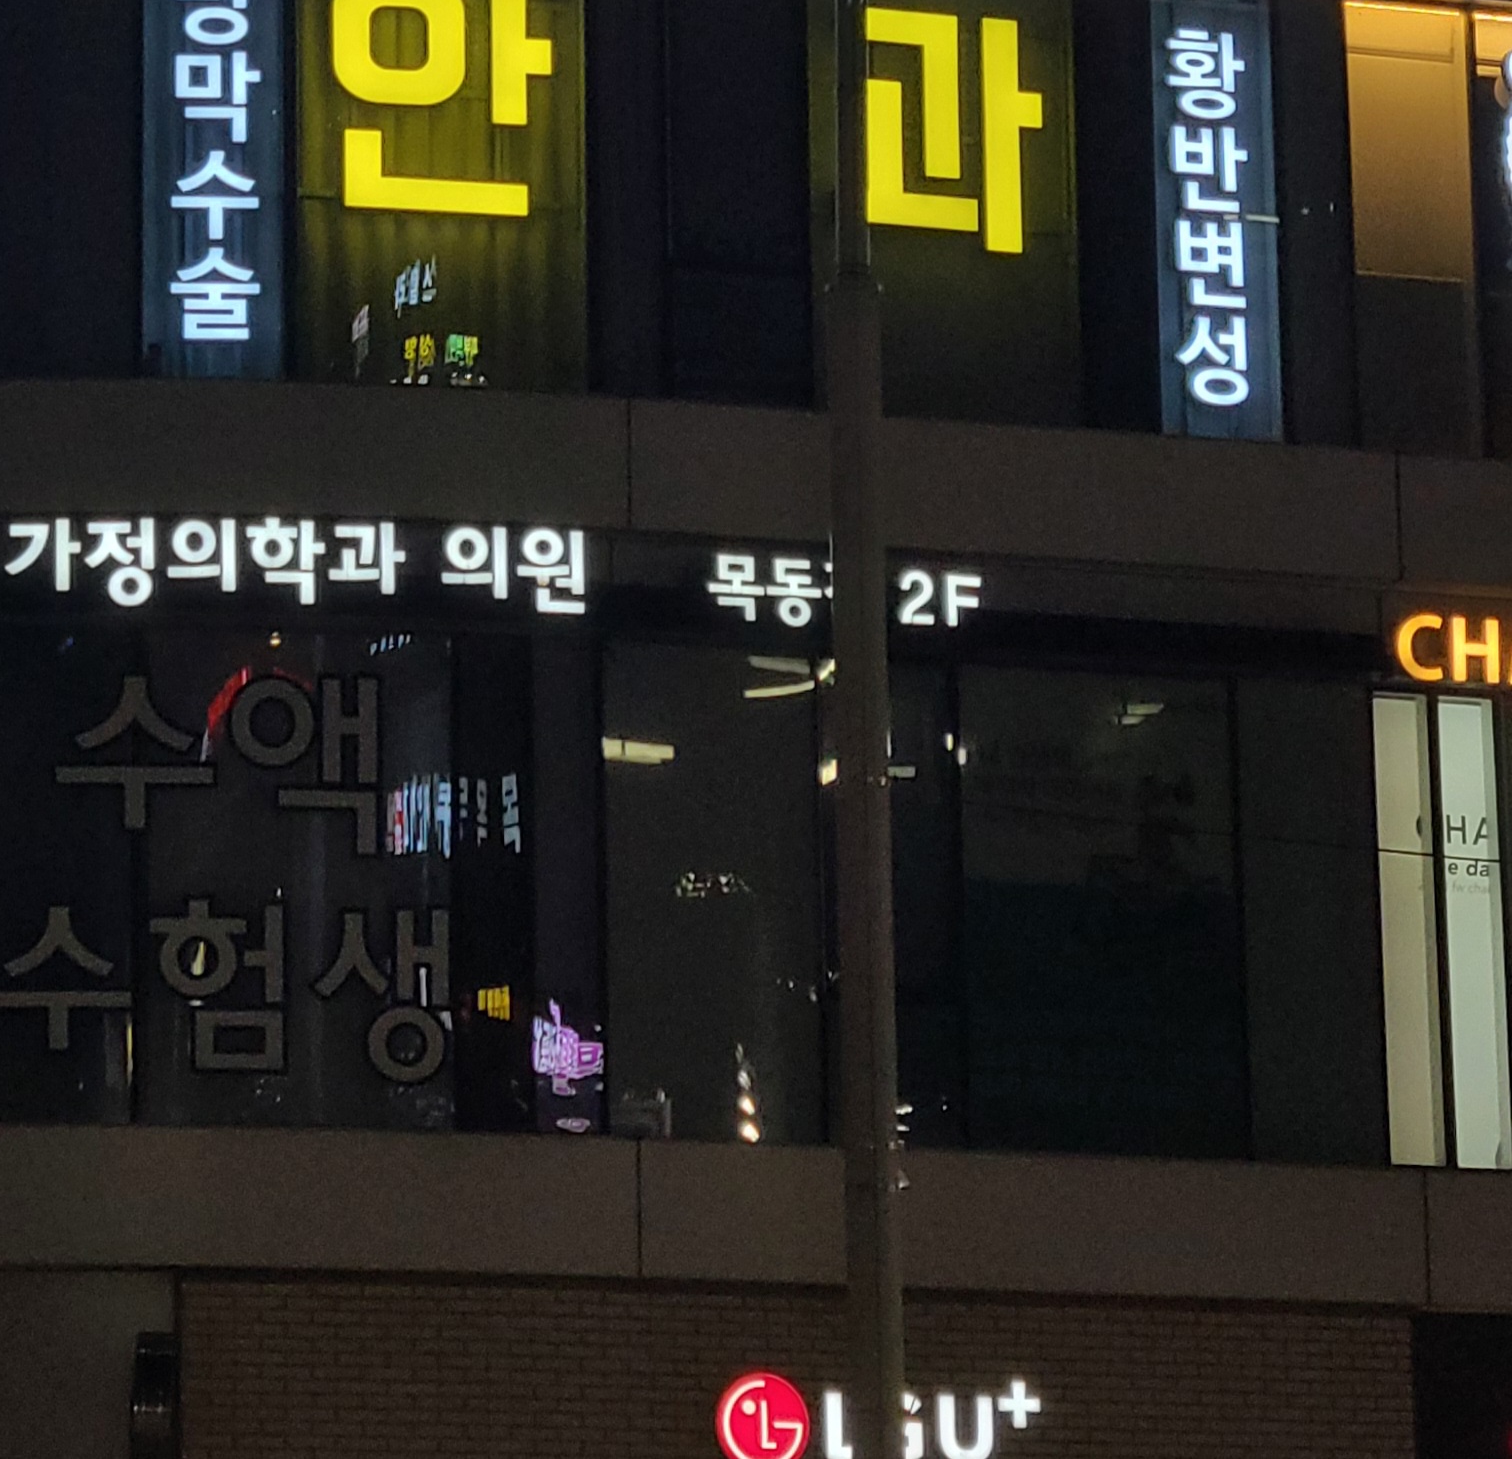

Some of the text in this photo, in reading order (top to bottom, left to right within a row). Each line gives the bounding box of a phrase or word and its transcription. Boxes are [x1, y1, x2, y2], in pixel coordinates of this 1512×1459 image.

[1166, 27, 1251, 407] 황반변성
[4, 517, 406, 607] 가정의학과
[441, 526, 586, 615] 의원
[707, 554, 833, 628] 목동
[899, 568, 982, 628] 2F
[1396, 613, 1512, 685] CH
[55, 673, 380, 856] 수액
